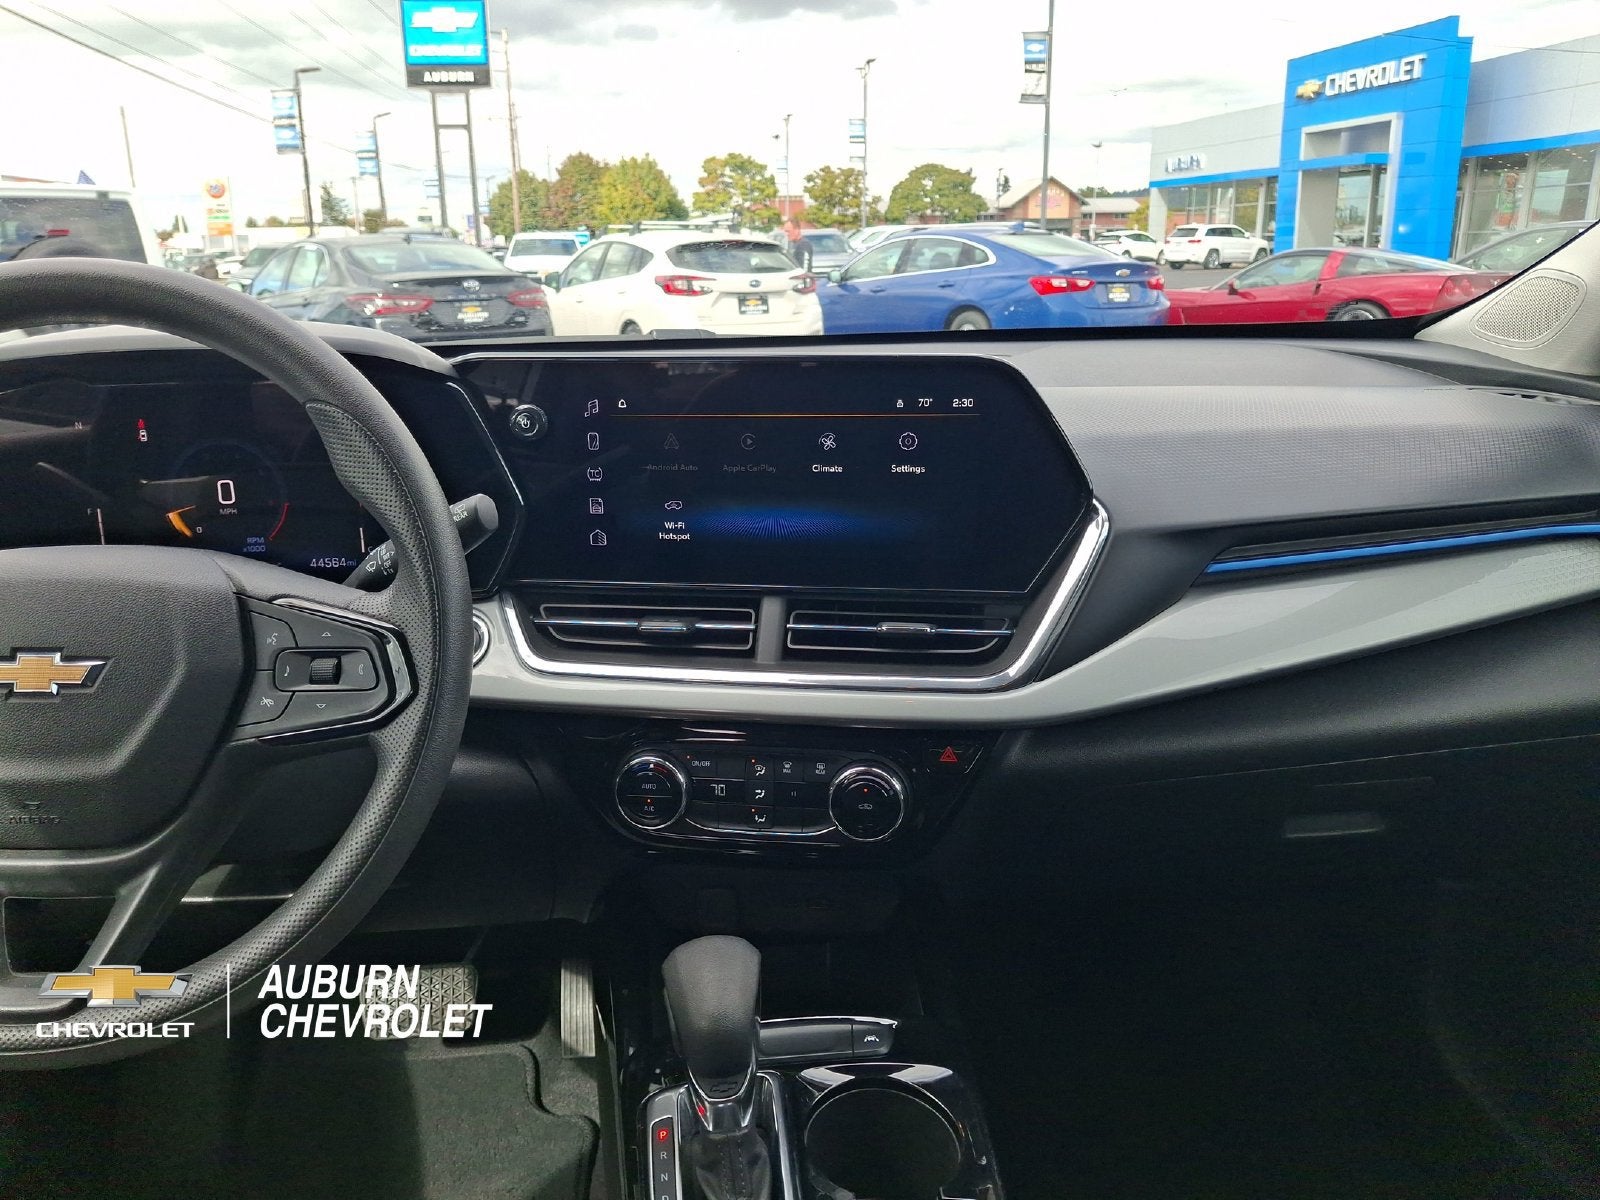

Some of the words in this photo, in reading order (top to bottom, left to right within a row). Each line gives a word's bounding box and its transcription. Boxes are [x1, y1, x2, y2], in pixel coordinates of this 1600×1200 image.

[1324, 54, 1427, 97] CHEVROLET
[952, 398, 974, 408] 2:30
[74, 421, 83, 430] N
[680, 464, 699, 472] Auto
[722, 464, 746, 473] Apple
[747, 464, 777, 474] CarPlay
[811, 464, 843, 474] Climate
[891, 464, 926, 475] Settings
[216, 479, 236, 505] 0
[219, 508, 237, 516] MPH
[453, 511, 468, 522] REAR
[664, 521, 685, 530] Wi-Fi
[246, 536, 265, 544] RPM
[658, 532, 690, 542] Hotspot
[691, 760, 711, 768] ON/OFF
[709, 784, 726, 796] 70
[660, 1130, 667, 1139] P
[660, 1151, 668, 1160] R
[660, 1172, 669, 1182] N
